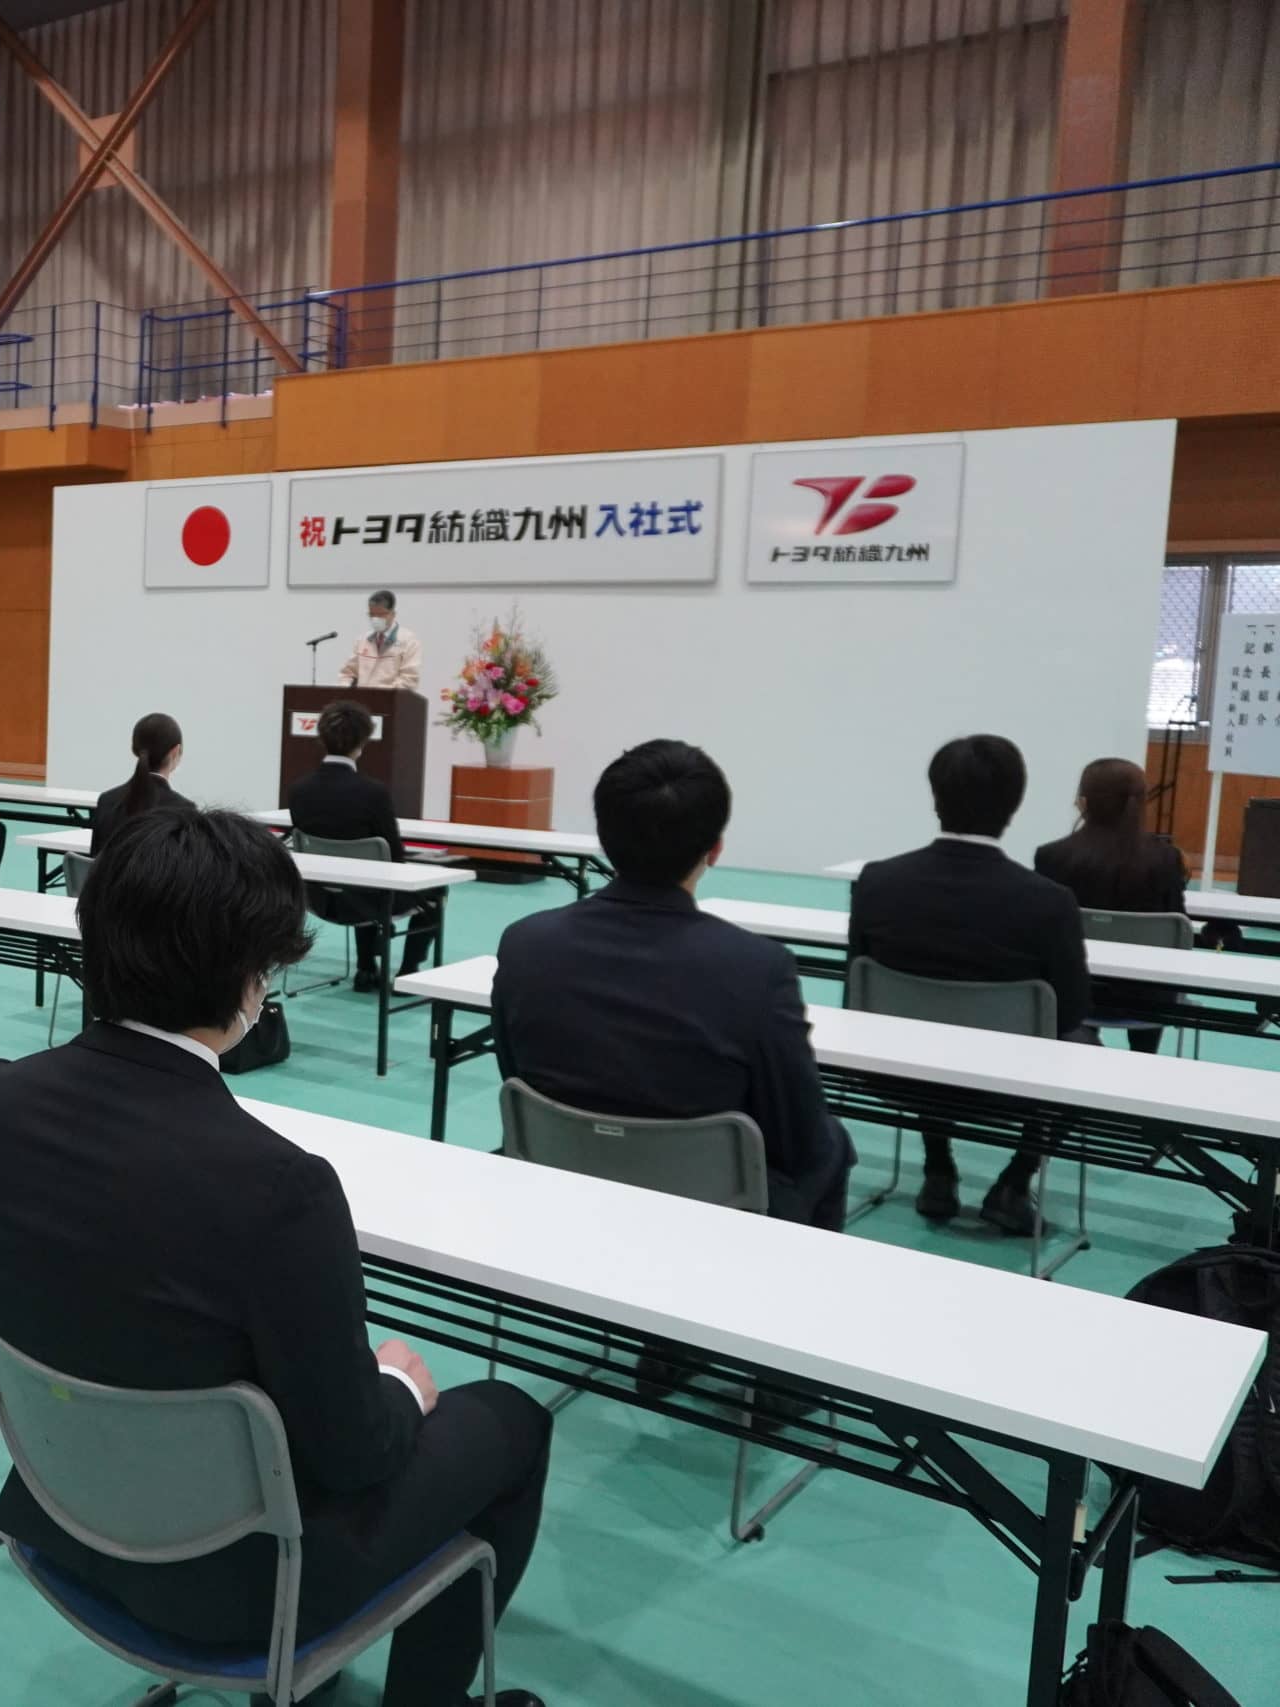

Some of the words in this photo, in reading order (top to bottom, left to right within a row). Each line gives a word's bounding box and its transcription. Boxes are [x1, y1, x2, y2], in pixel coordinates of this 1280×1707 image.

[770, 543, 930, 563] トヨタ紡織九州
